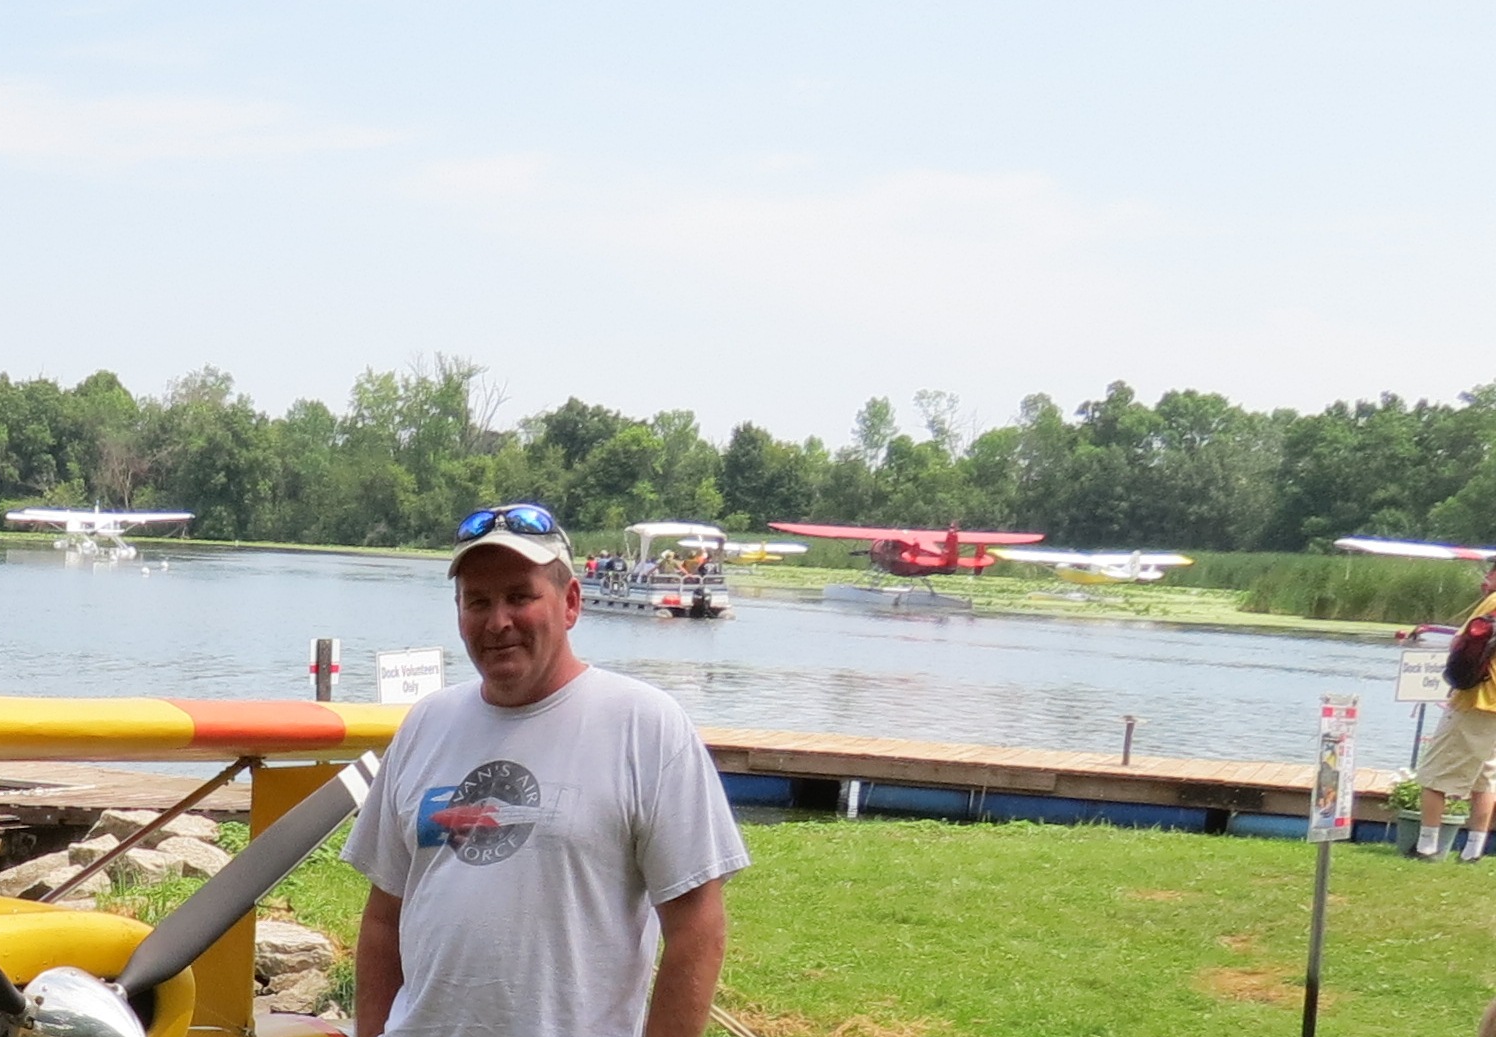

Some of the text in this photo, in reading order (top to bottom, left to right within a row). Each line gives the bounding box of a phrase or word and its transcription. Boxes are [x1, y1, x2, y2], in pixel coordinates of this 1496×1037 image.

[382, 664, 399, 679] Dock
[403, 680, 418, 694] Only
[1423, 676, 1440, 690] Only
[453, 764, 538, 804] VAN'S AIR
[463, 833, 518, 862] ORCE
